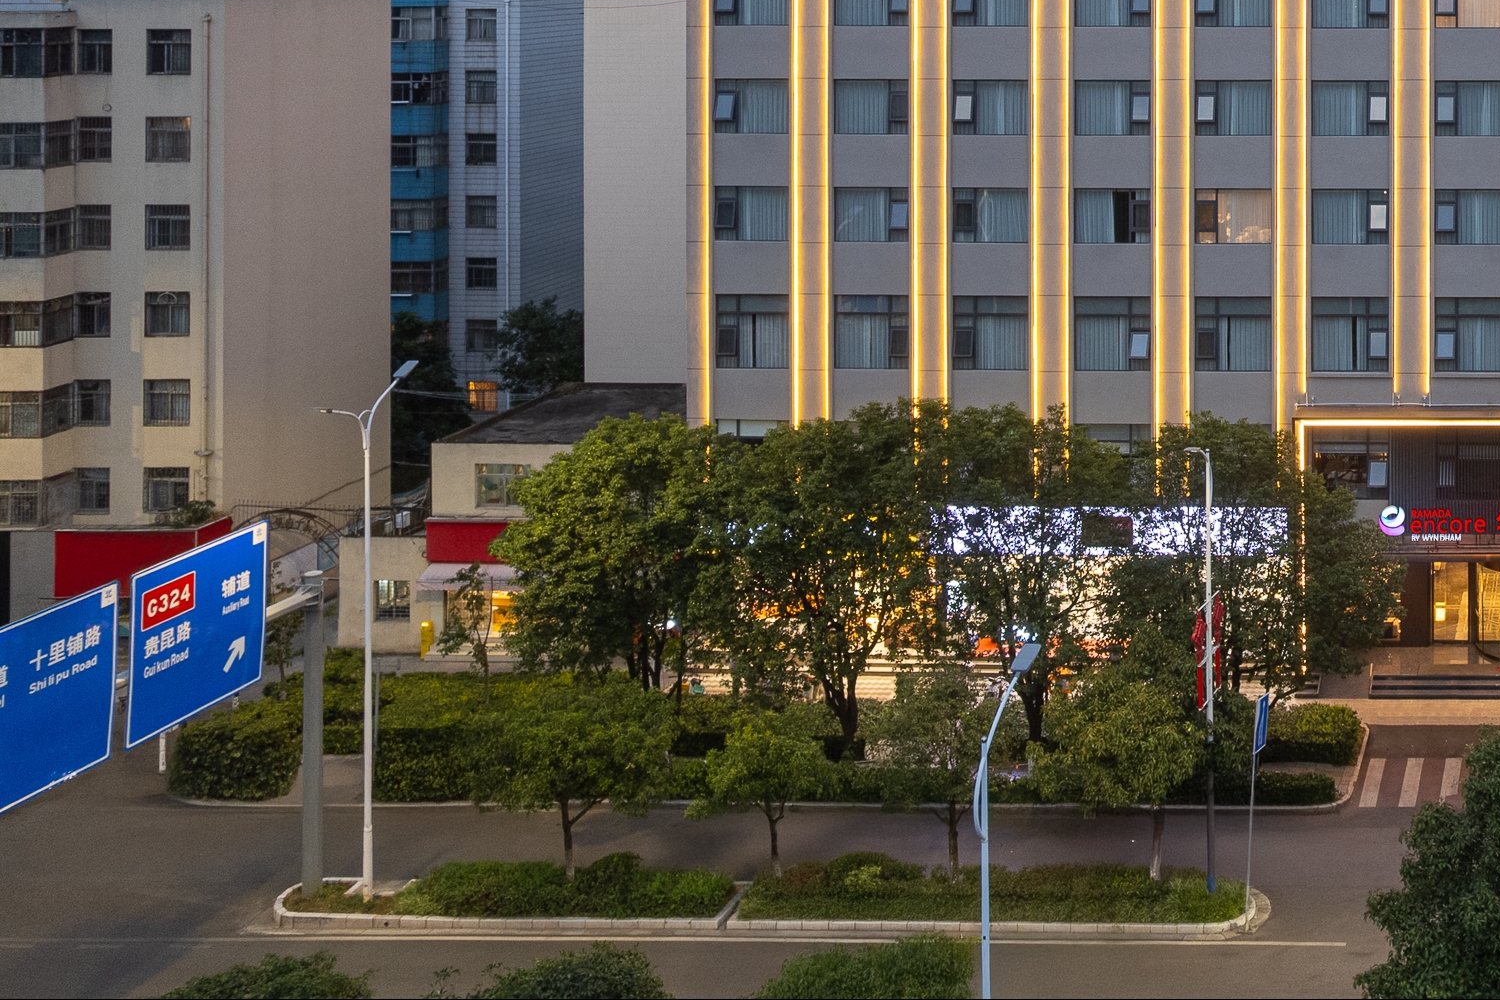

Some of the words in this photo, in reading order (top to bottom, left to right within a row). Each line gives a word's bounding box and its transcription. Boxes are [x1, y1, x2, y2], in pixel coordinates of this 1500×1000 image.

[1411, 508, 1451, 518] RAMADA
[1410, 518, 1486, 534] encore
[221, 570, 251, 598] 辅道
[147, 583, 191, 618] G324
[29, 625, 101, 671] 十里铺路
[143, 621, 191, 660] 贵昆路
[71, 655, 98, 675] Road
[170, 647, 189, 665] Road
